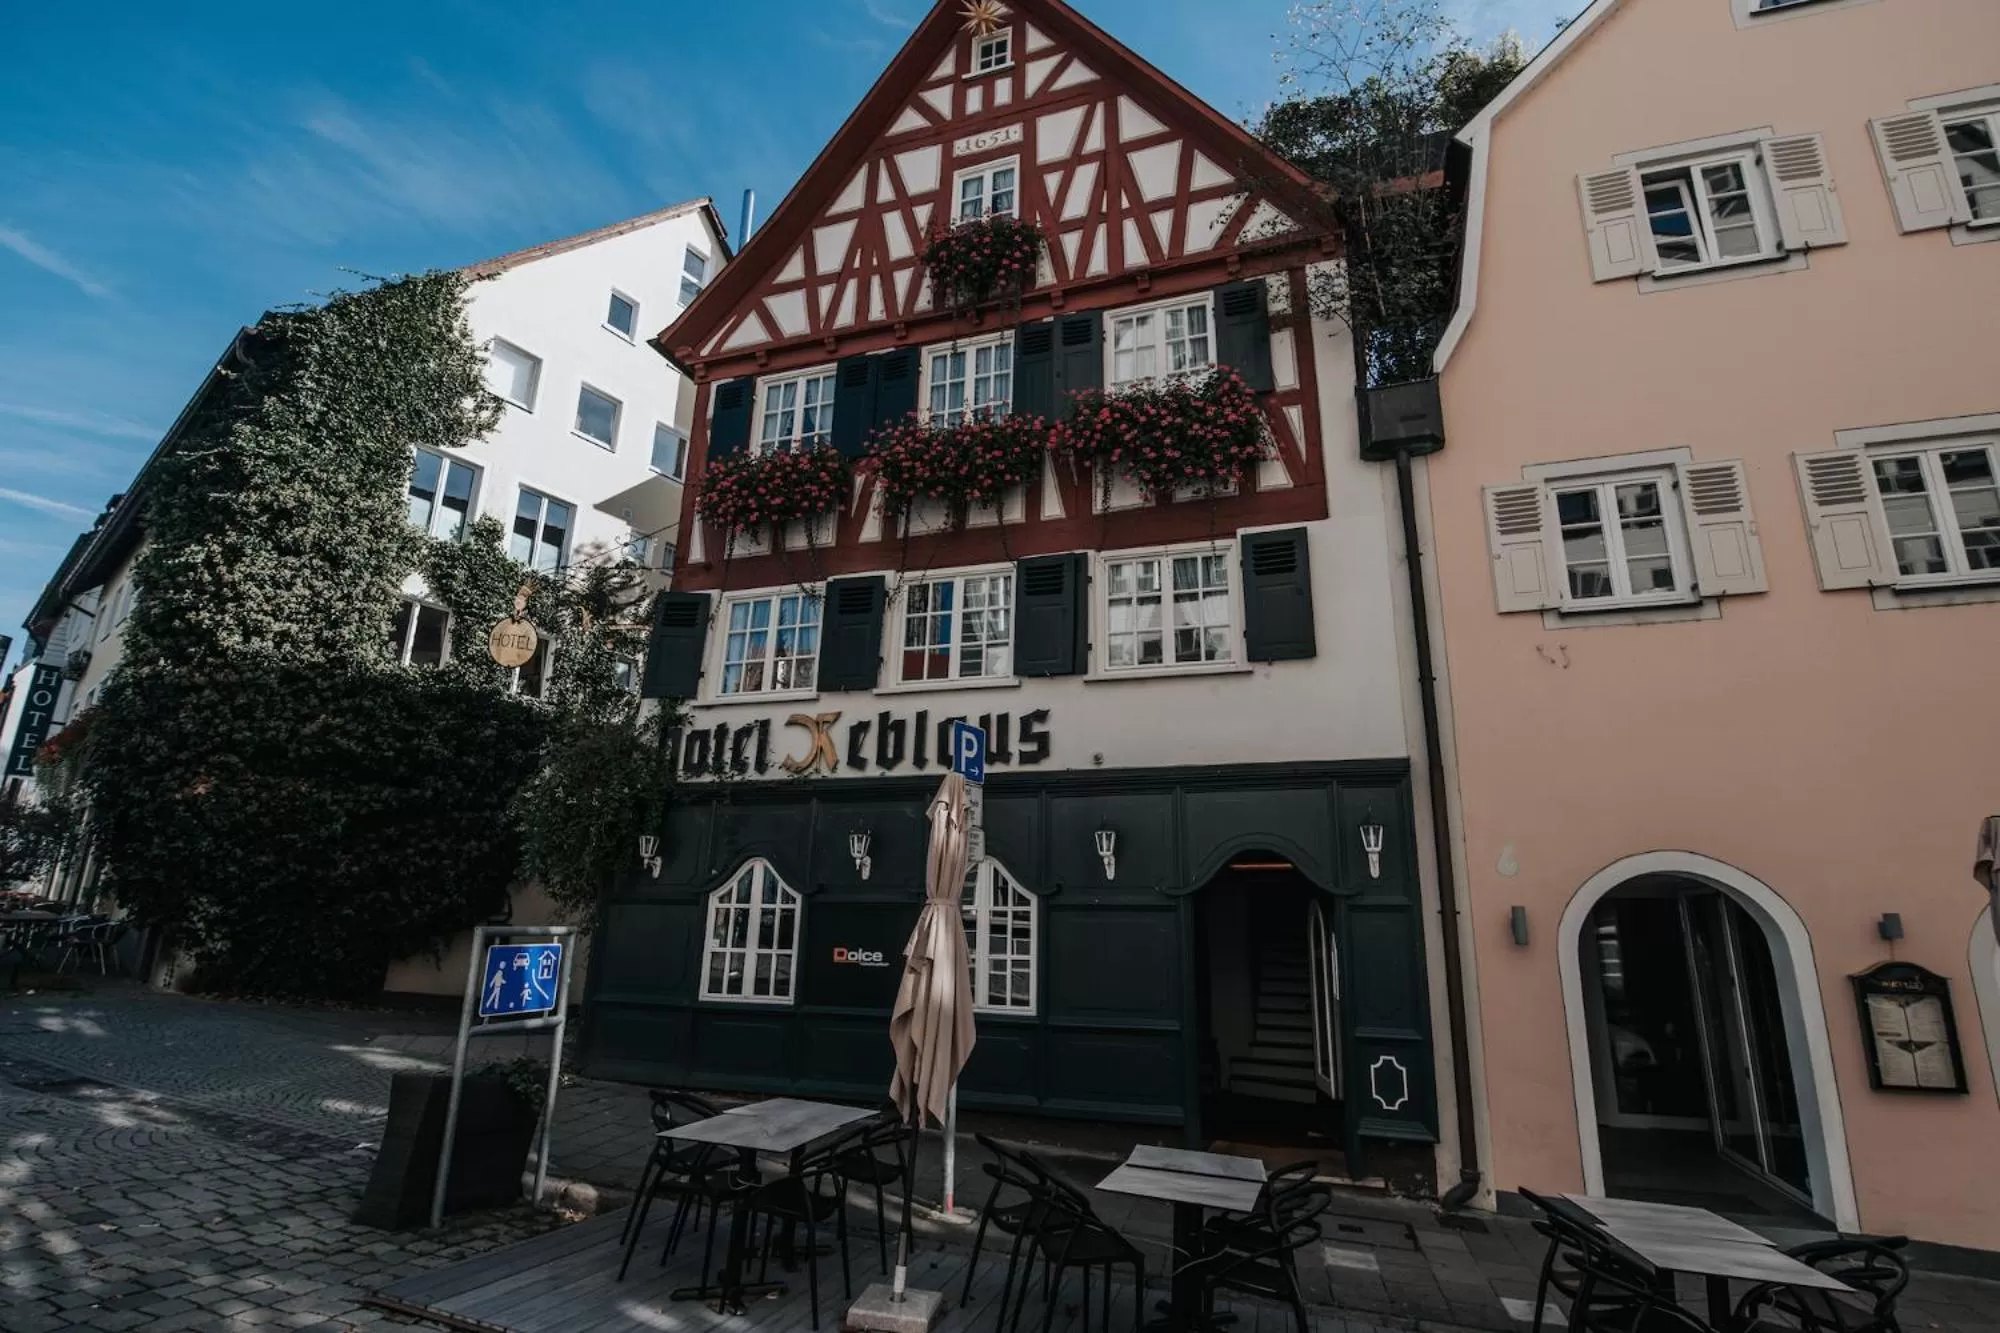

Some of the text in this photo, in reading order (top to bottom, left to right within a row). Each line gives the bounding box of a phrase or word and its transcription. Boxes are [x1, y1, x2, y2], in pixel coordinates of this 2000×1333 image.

[491, 632, 533, 651] HOTEL
[16, 670, 58, 772] HOTEL
[960, 730, 979, 772] P
[833, 947, 883, 962] Dolce
